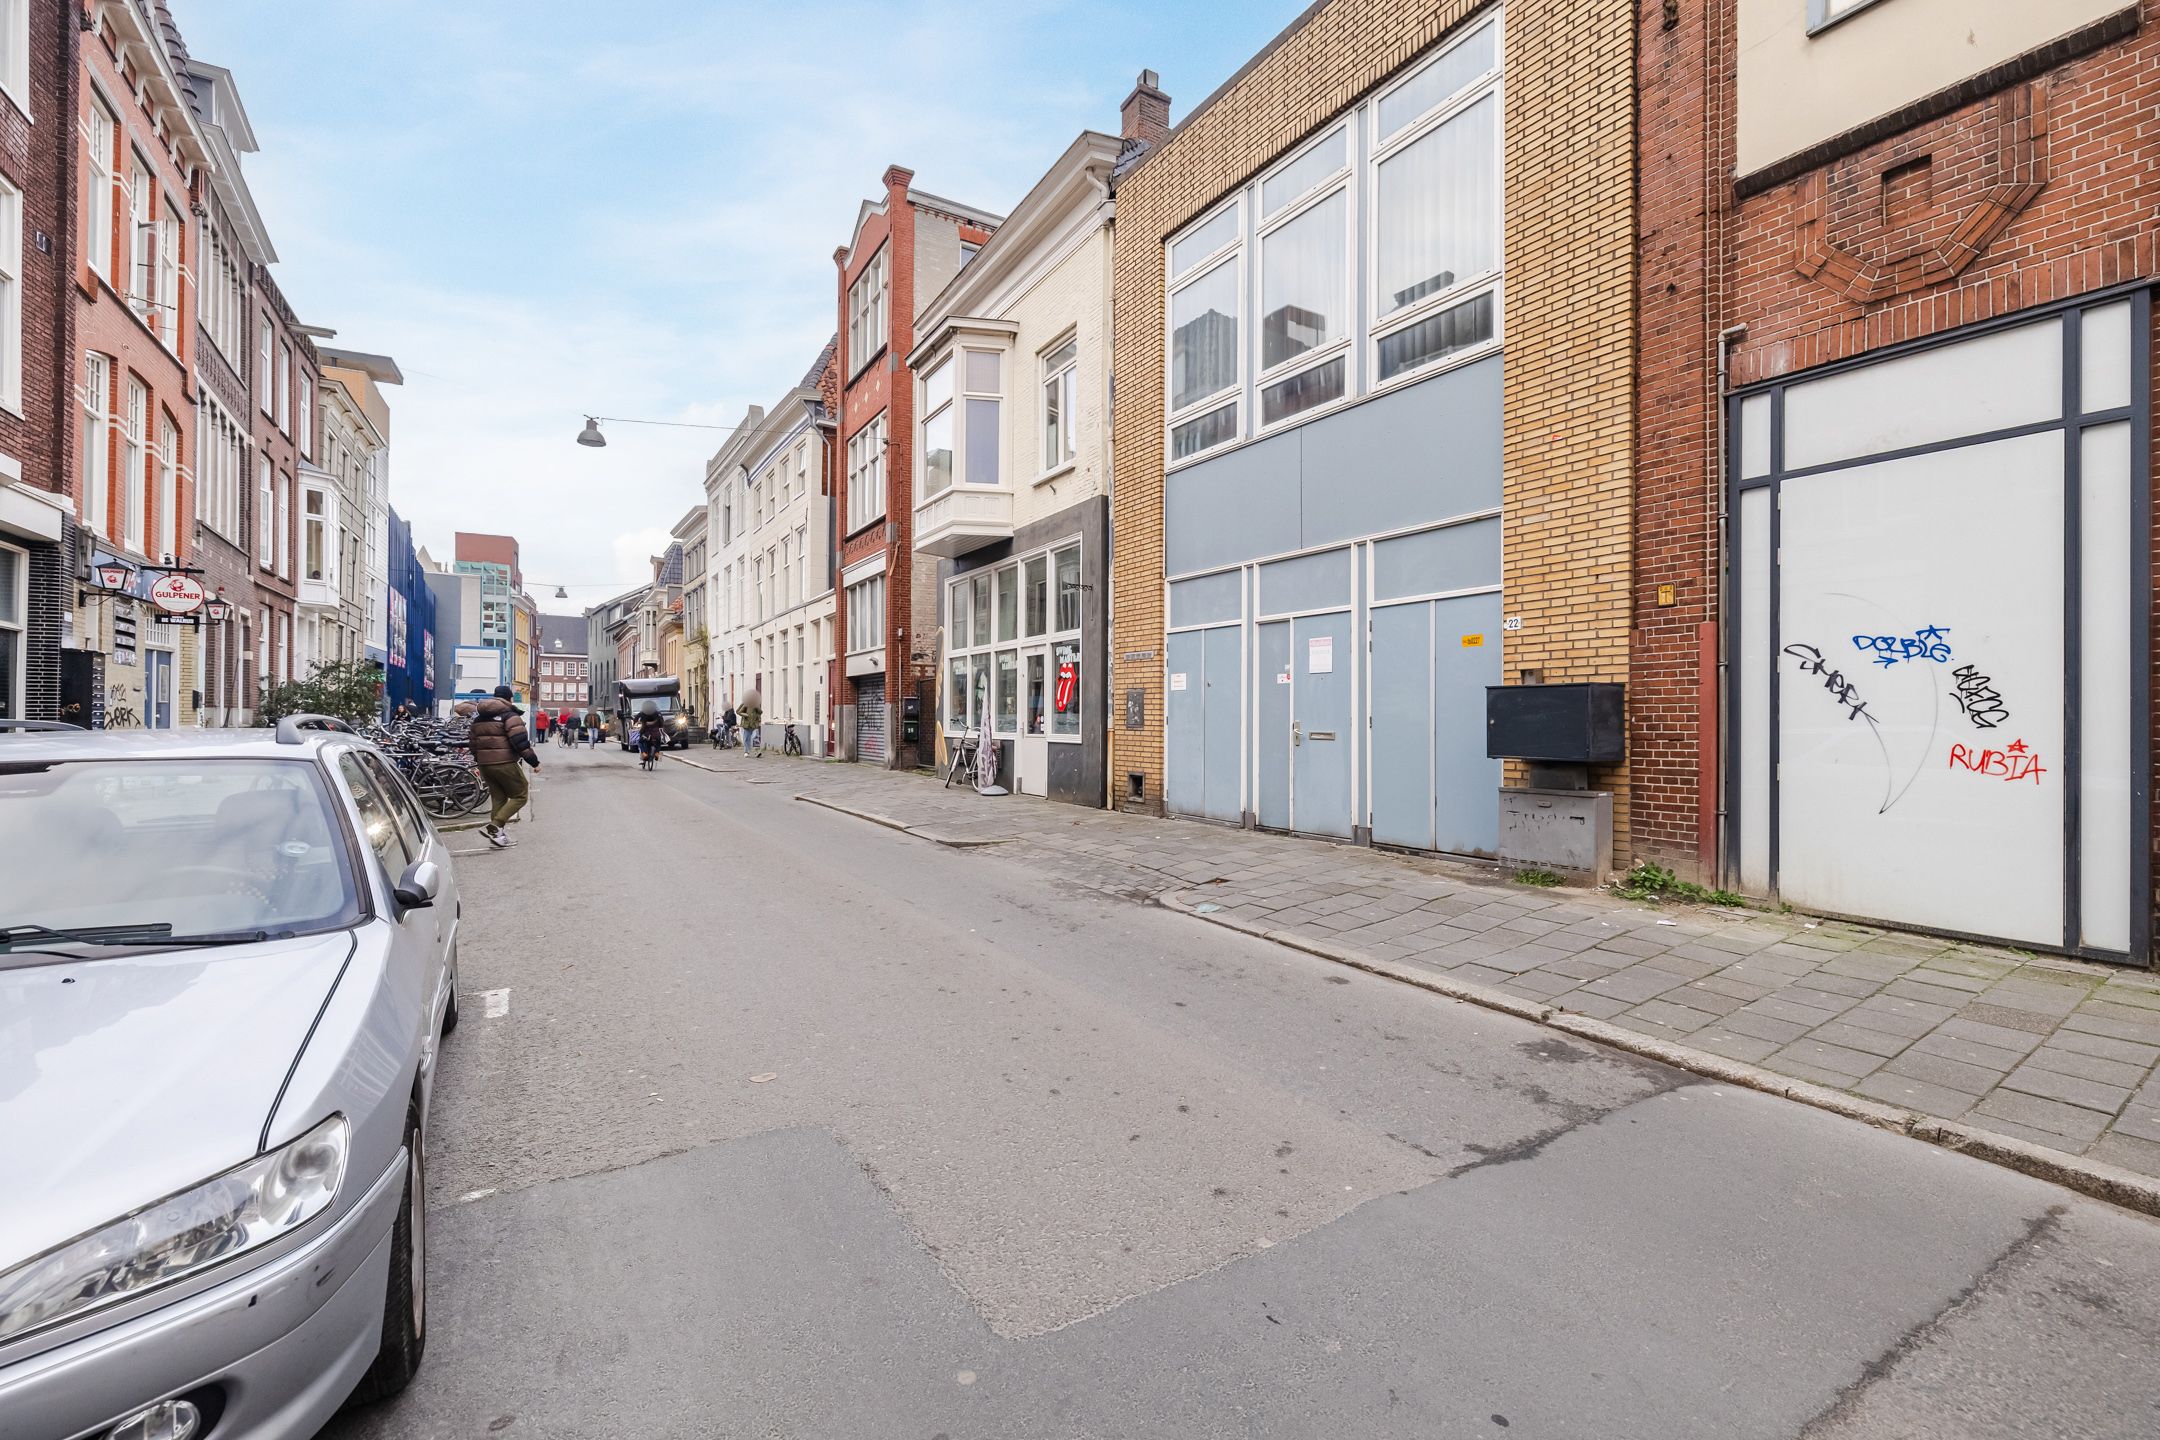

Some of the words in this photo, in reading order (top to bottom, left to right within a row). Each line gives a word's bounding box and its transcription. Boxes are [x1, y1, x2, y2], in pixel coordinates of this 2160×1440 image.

[155, 591, 200, 600] GULPENER
[1508, 618, 1519, 628] 22
[1949, 743, 2047, 785] RUBIA
